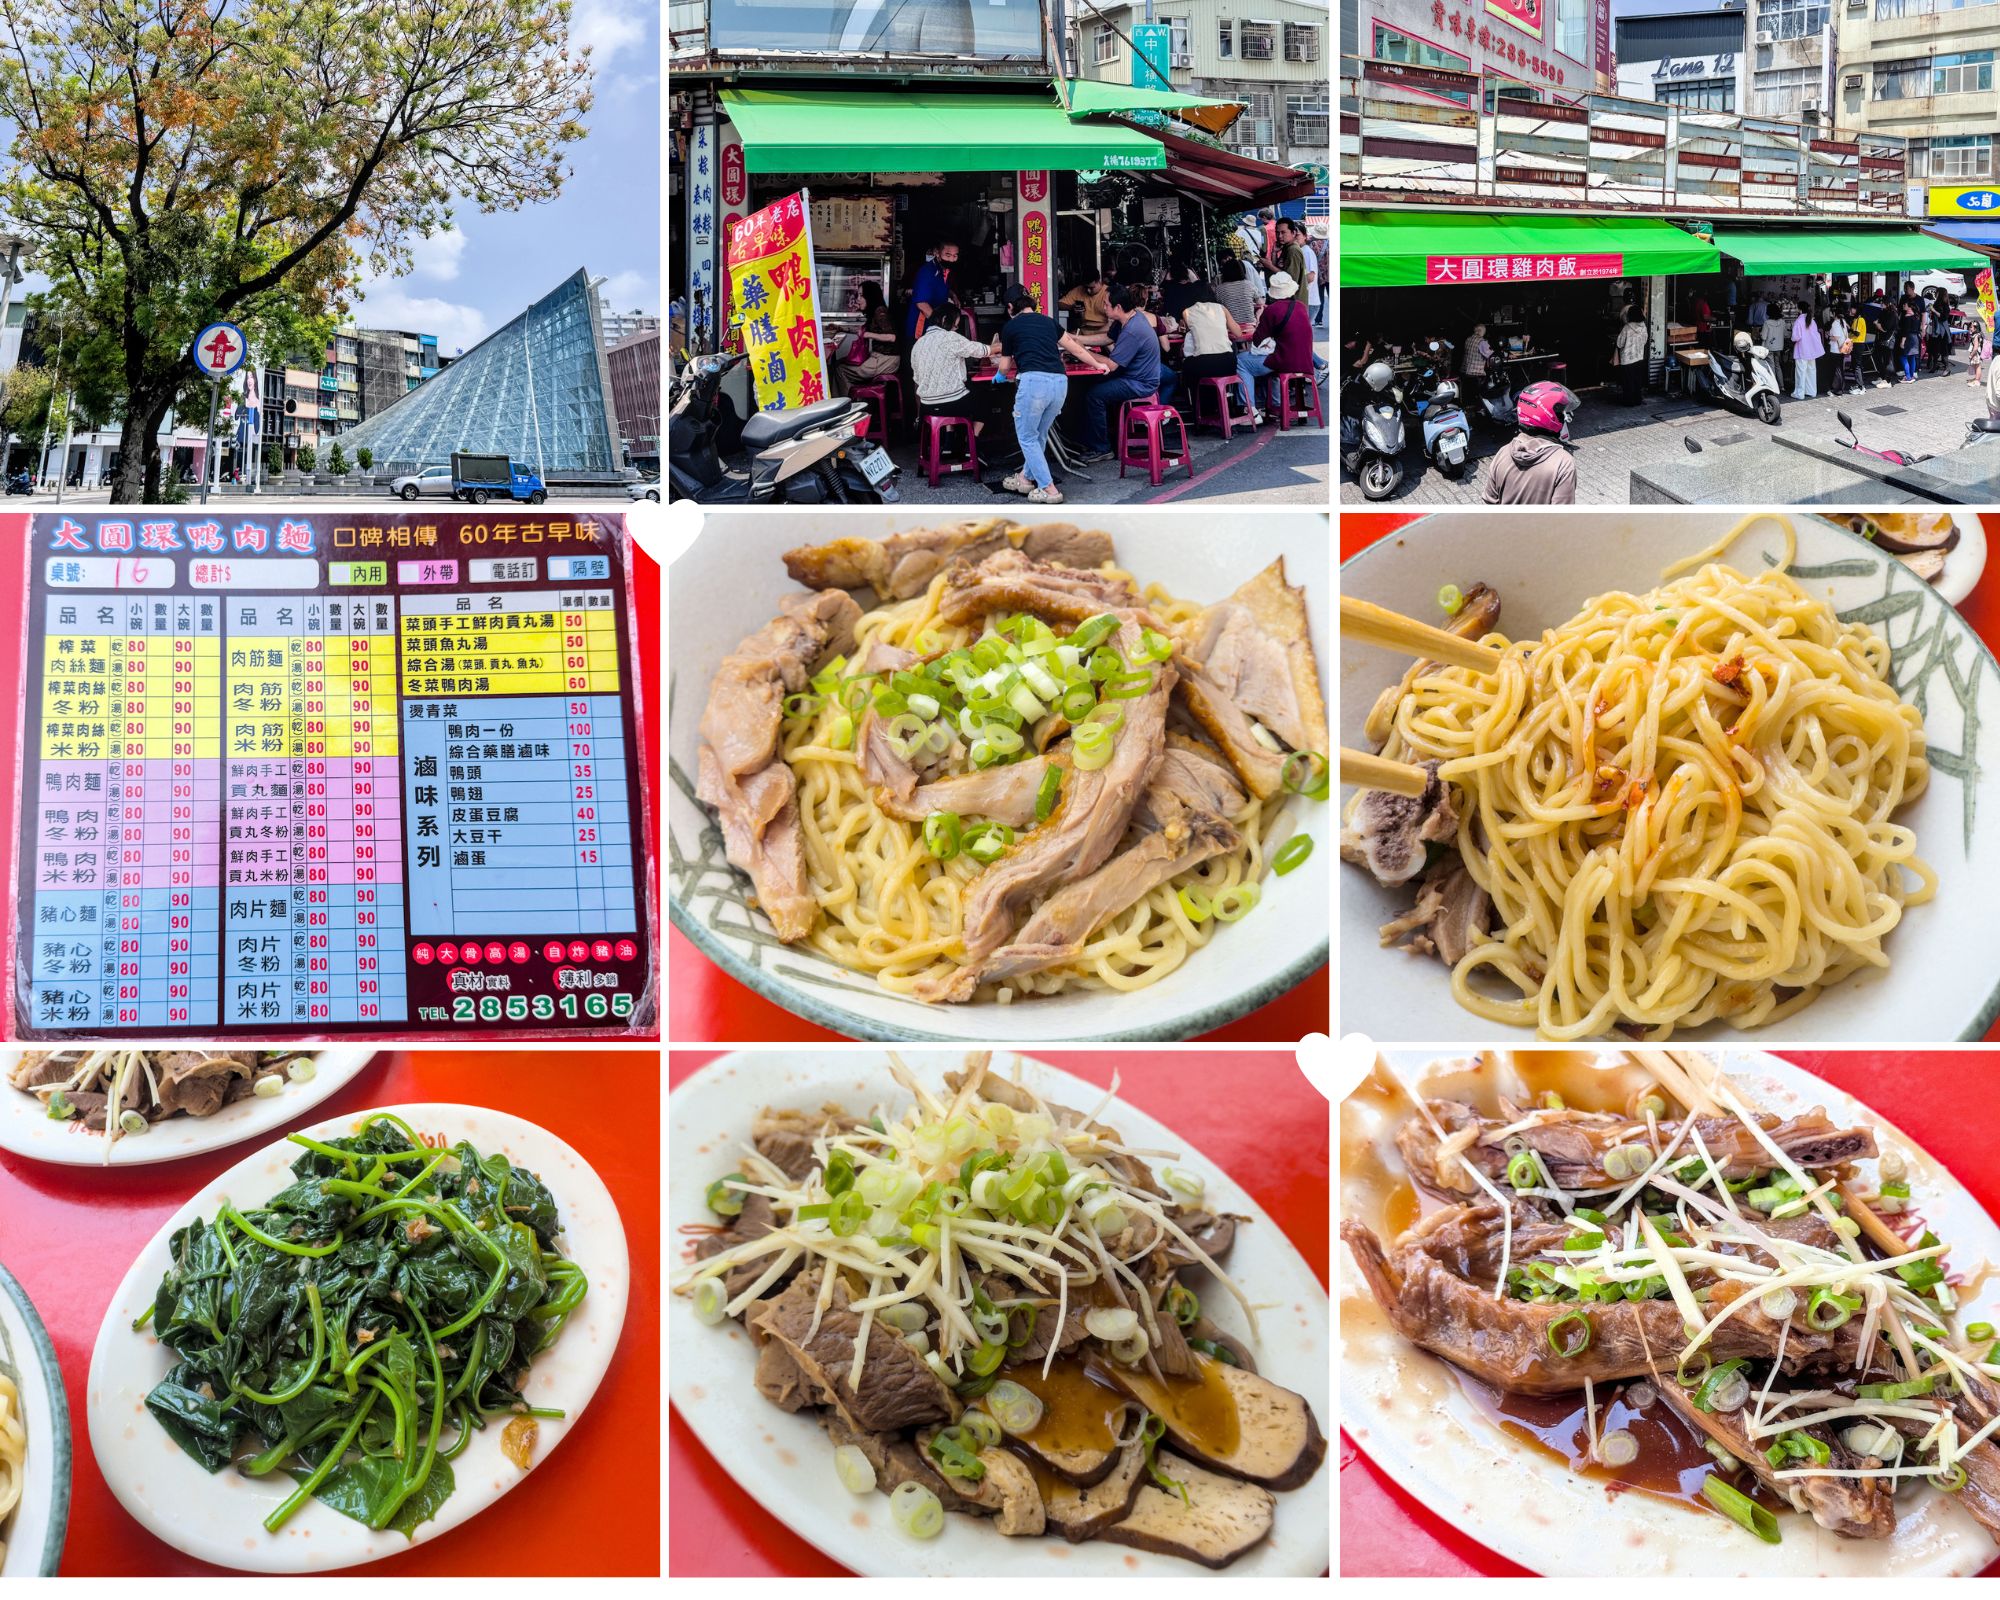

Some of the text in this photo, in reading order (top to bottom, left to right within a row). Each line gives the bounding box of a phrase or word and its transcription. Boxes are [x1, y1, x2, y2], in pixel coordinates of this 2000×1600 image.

[1651, 52, 1735, 79] Lane 12
[726, 147, 742, 204] 大圓環
[734, 198, 800, 243] 60年老店
[1026, 217, 1044, 266] 鴨肉麵
[1434, 257, 1577, 281] 大圓環雞肉飯
[53, 519, 315, 552] 大圓環鴨肉麵
[333, 522, 601, 547] 口碑相傳 60年古早味
[423, 564, 454, 580] 外帶
[492, 562, 535, 580] 電話訂
[572, 560, 605, 577] 隔壁
[405, 613, 582, 631] 菜頭手工鮮肉貢丸湯 50
[58, 639, 96, 654] 榨菜
[128, 639, 369, 653] 80 90 80 90
[405, 635, 583, 652] 菜頭魚丸湯 50
[50, 658, 106, 674] 肉絲麵
[231, 649, 284, 667] 肉筋麵
[407, 656, 456, 672] 綜合湯
[567, 655, 585, 669] 60
[48, 680, 106, 696] 榨菜肉絲
[127, 679, 369, 693] 80 90 80 90
[233, 682, 282, 696] 肉筋
[407, 676, 586, 692] 冬菜鴨肉湯 60
[52, 699, 100, 715] 冬粉
[233, 697, 282, 711] 冬粉
[409, 702, 588, 718] 燙青菜 50
[46, 722, 105, 738] 榨菜肉絲
[127, 720, 371, 734] 80 90 80 90
[235, 723, 284, 736] 肉筋
[448, 723, 591, 739] 鴨肉一份 100
[50, 741, 100, 757] 米粉
[234, 738, 284, 752] 米粉
[448, 743, 590, 759] 綜合藥膳滷味 70
[126, 760, 373, 776] 80 90 80 90
[231, 762, 287, 777] 鮮肉手工
[450, 764, 592, 780] 鴨頭 35
[45, 772, 102, 792] 鴨肉麵
[230, 783, 288, 797] 貢丸麵
[450, 785, 593, 801] 鴨翅 25
[44, 809, 99, 824] 鴨肉
[231, 806, 287, 820] 鮮肉手工
[413, 755, 441, 868] 滷味系列
[452, 807, 595, 823] 皮蛋豆腐 40
[44, 826, 99, 841] 冬粉
[124, 823, 374, 841] 80 90 80 90
[229, 825, 289, 838] 貢丸冬粉
[453, 828, 596, 844] 大豆干 25
[43, 851, 97, 866] 鴨肉
[230, 849, 288, 863] 鮮肉手工
[453, 850, 598, 866] 滷蛋 15
[42, 868, 97, 883] 米粉
[123, 866, 376, 886] 80 90 80 90
[228, 869, 289, 883] 貢丸米粉
[40, 904, 97, 923] 豬心麵
[230, 898, 288, 919] 肉片麵
[42, 942, 93, 957] 豬心
[121, 934, 376, 953] 80 90 80 90
[237, 935, 281, 953] 肉片
[42, 958, 93, 974] 冬粉
[237, 954, 281, 972] 冬粉
[40, 989, 92, 1005] 豬心
[119, 980, 377, 999] 80 90 80 90
[237, 981, 281, 999] 肉片
[40, 1005, 91, 1022] 米粉
[237, 1001, 281, 1018] 米粉
[418, 993, 634, 1022] TEL 2853165
